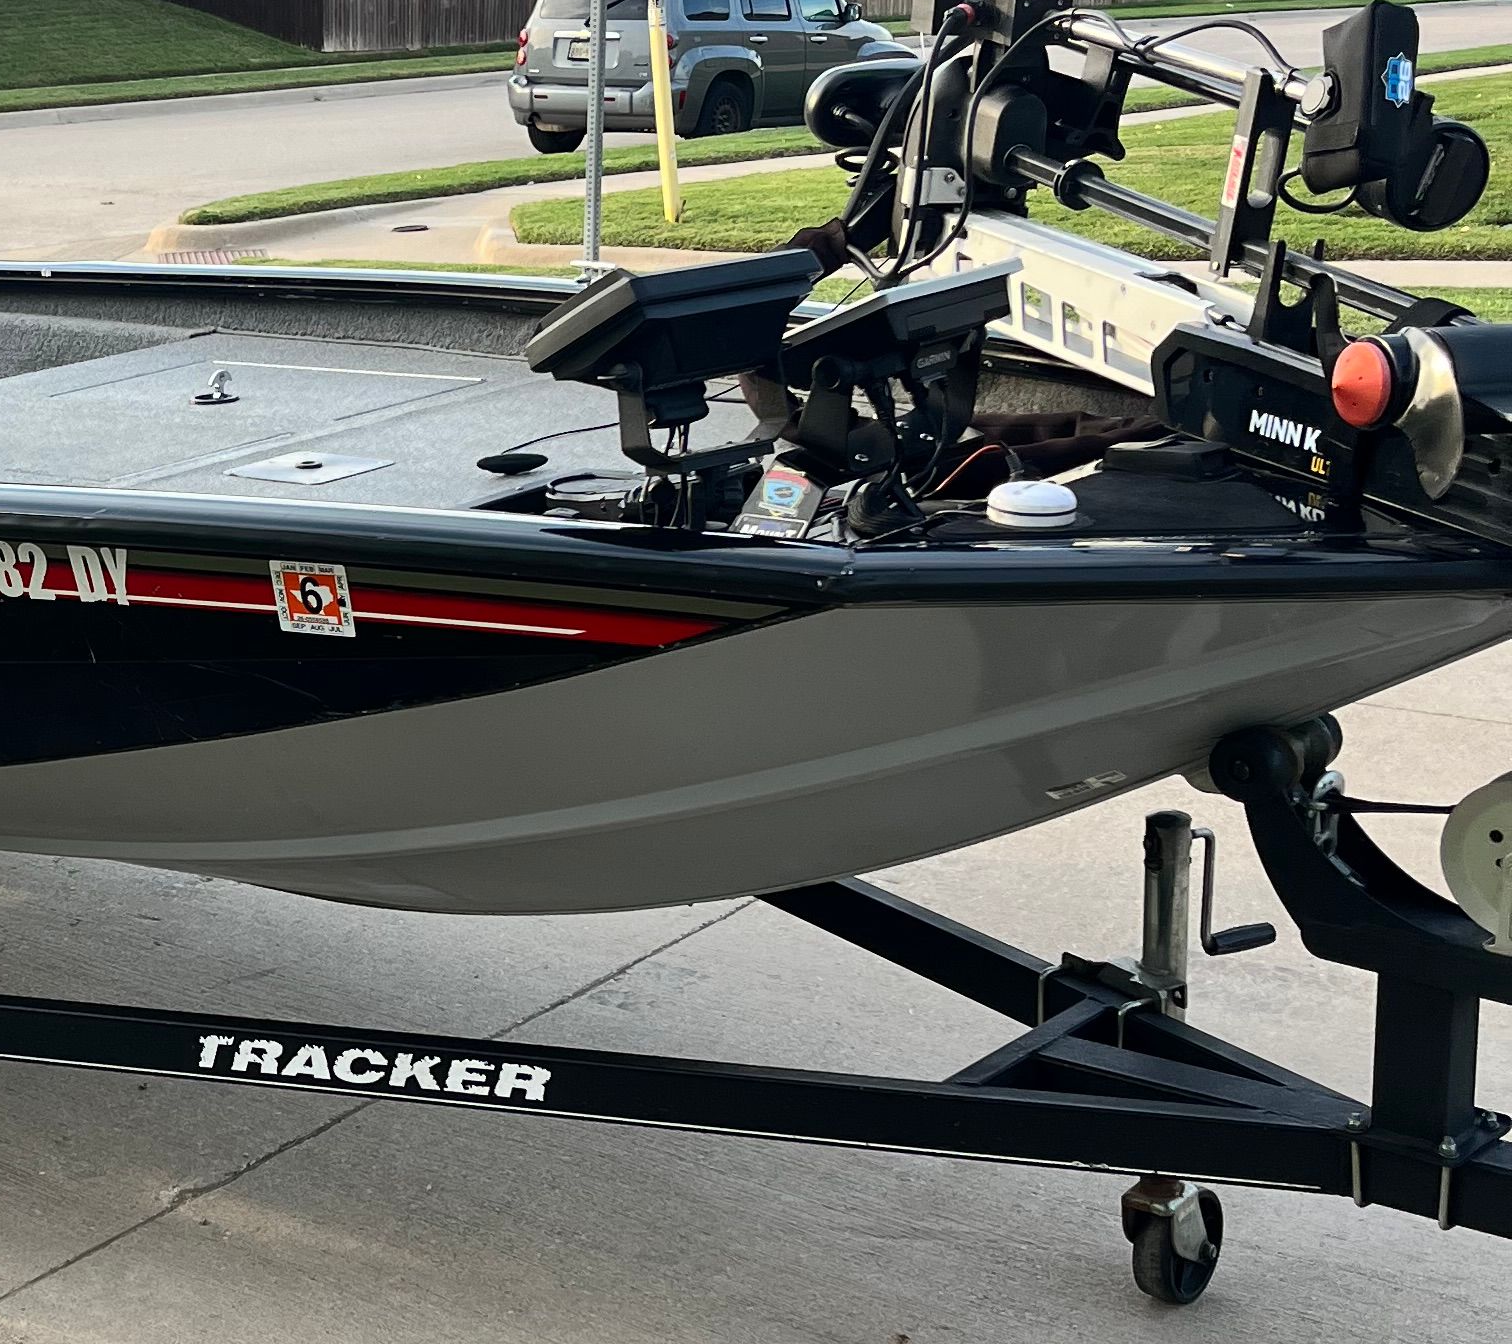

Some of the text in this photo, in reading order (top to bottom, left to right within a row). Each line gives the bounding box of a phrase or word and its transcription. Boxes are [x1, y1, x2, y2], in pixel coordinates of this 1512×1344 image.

[1249, 409, 1304, 448] MINN
[66, 544, 130, 607] DY
[300, 577, 323, 615] 6
[199, 1034, 552, 1102] TRACKER
